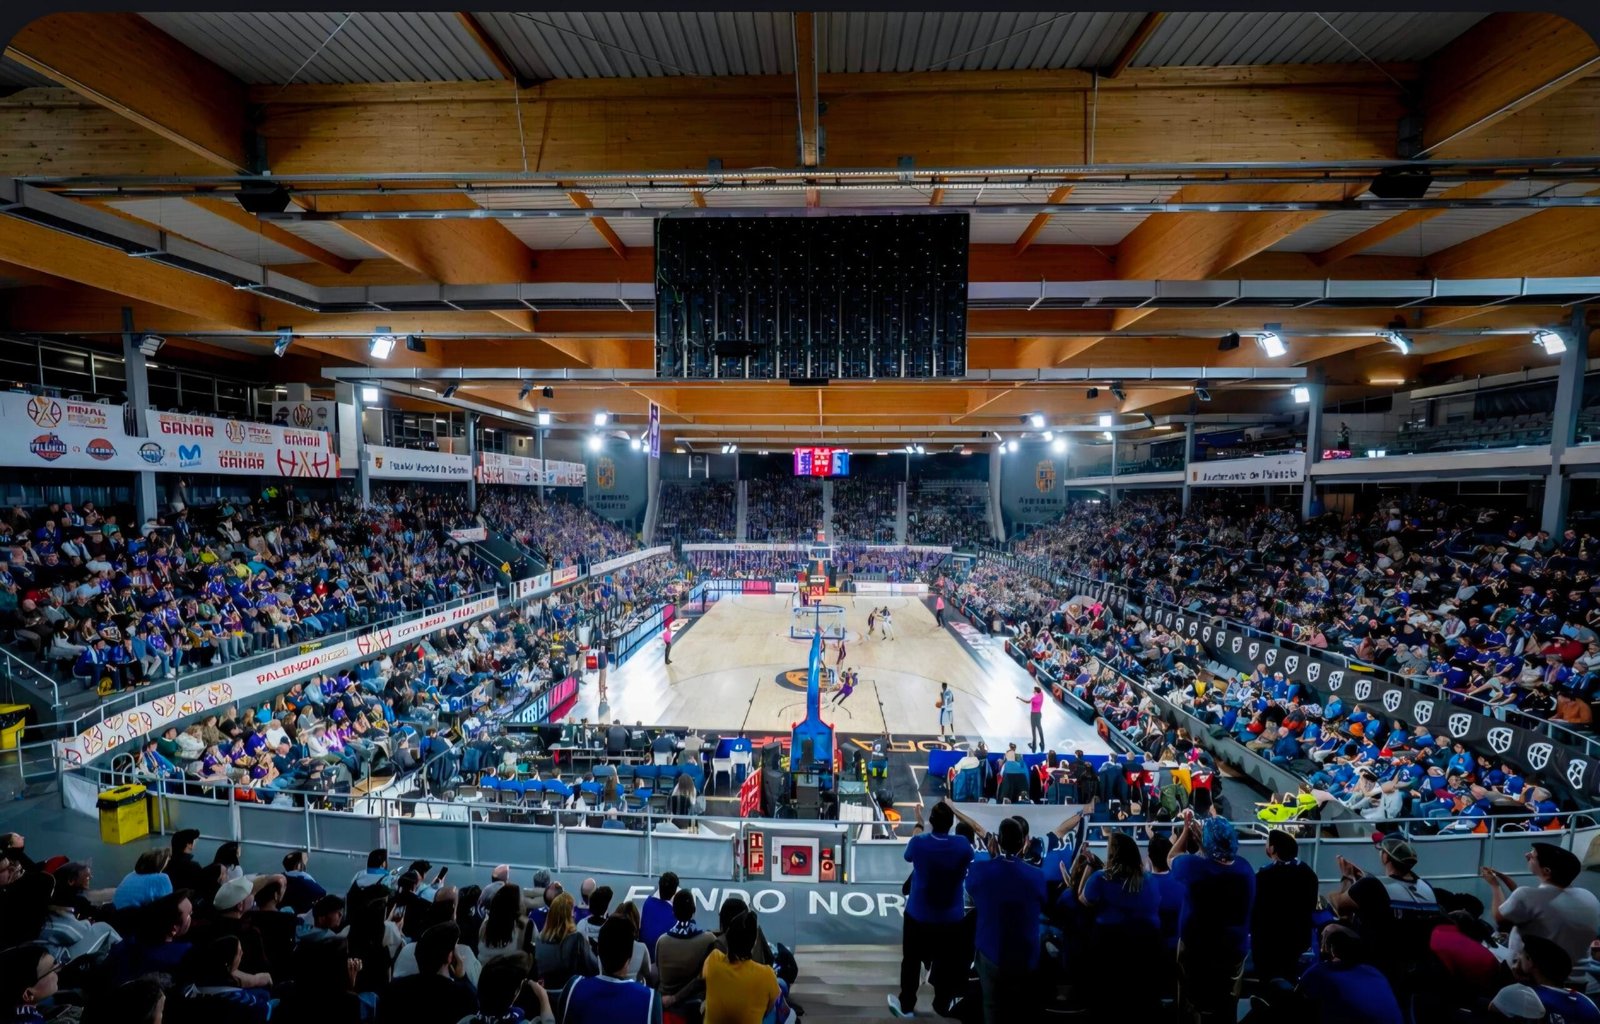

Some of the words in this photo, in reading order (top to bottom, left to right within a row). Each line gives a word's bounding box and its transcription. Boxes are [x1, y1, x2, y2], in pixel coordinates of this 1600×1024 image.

[159, 420, 214, 438] GANAR
[219, 456, 265, 470] GANAR
[623, 884, 787, 914] FNDO
